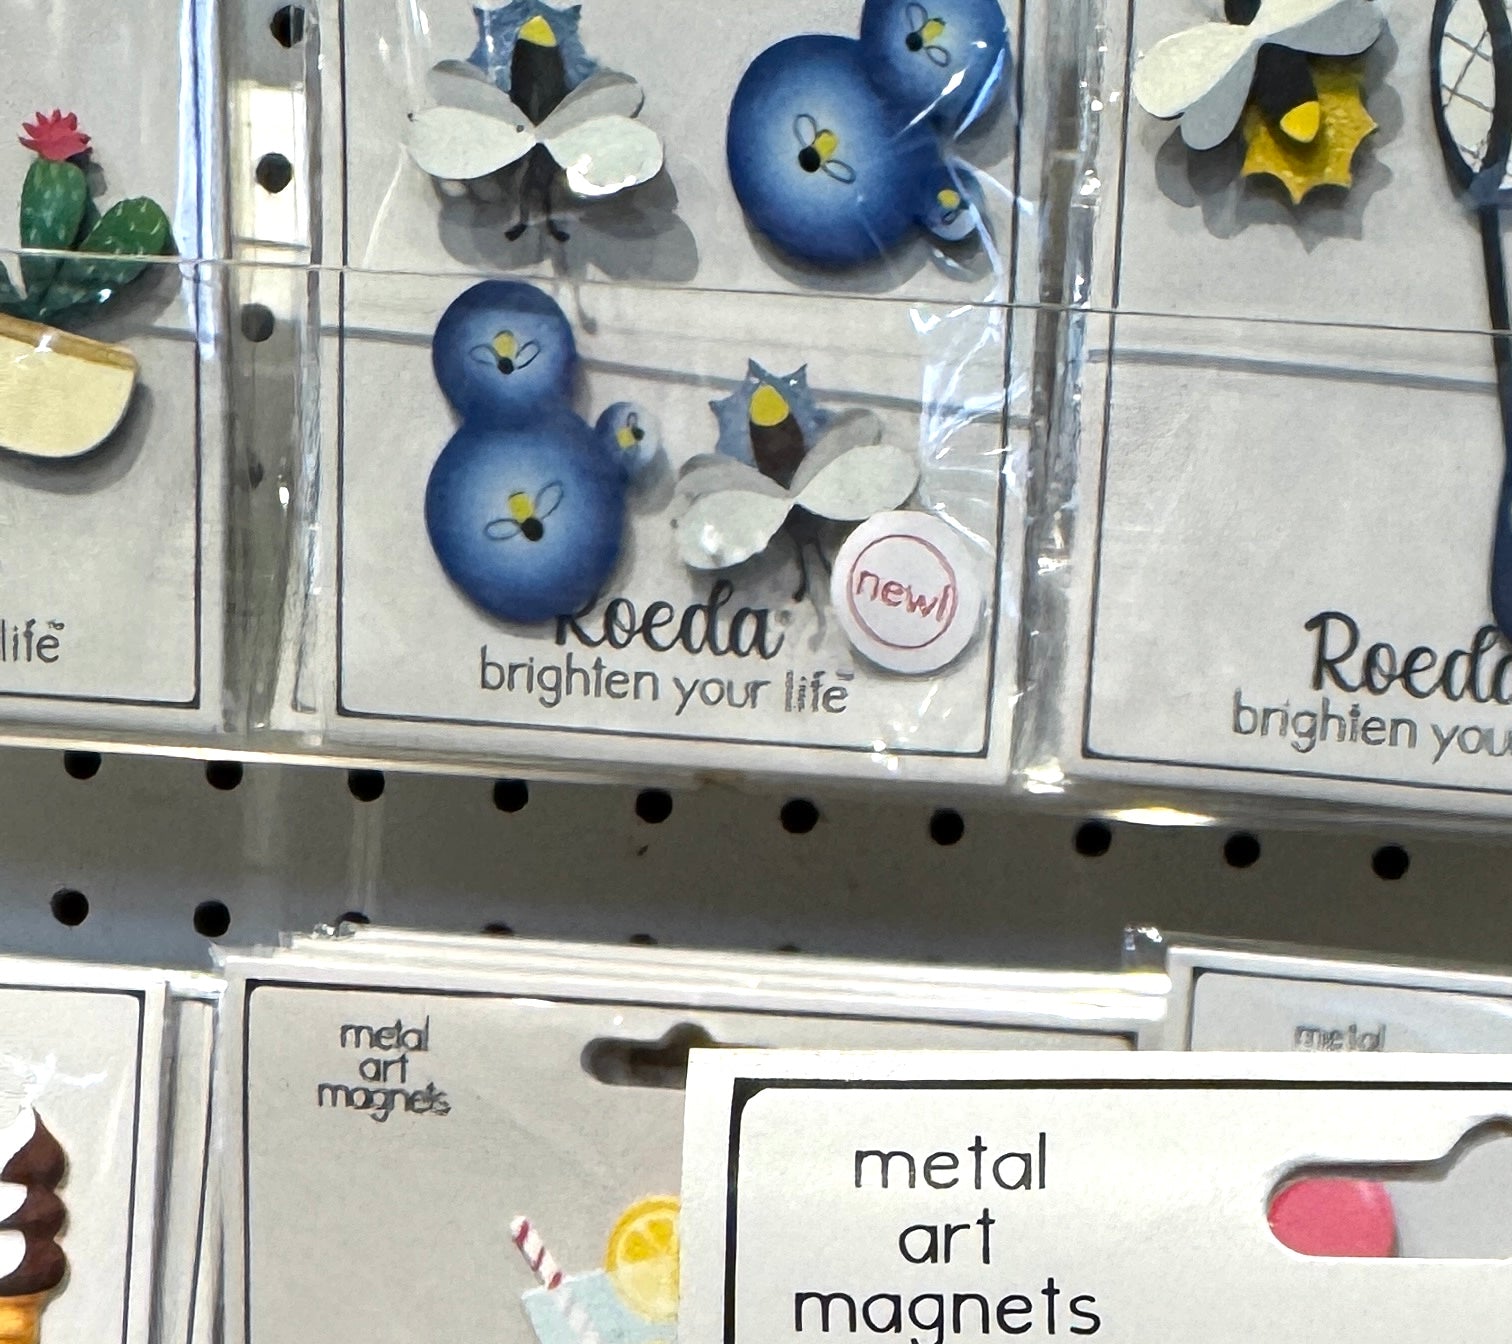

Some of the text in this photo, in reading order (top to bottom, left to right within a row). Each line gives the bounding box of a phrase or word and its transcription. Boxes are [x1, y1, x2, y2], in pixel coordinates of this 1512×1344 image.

[855, 569, 952, 623] new!
[479, 644, 660, 709] brighten
[672, 676, 772, 717] your
[1231, 688, 1417, 754] brighten
[339, 1014, 431, 1054] metal
[356, 1053, 410, 1086] art
[317, 1081, 452, 1123] magnets
[854, 1131, 1047, 1191] metal
[898, 1207, 996, 1265] art
